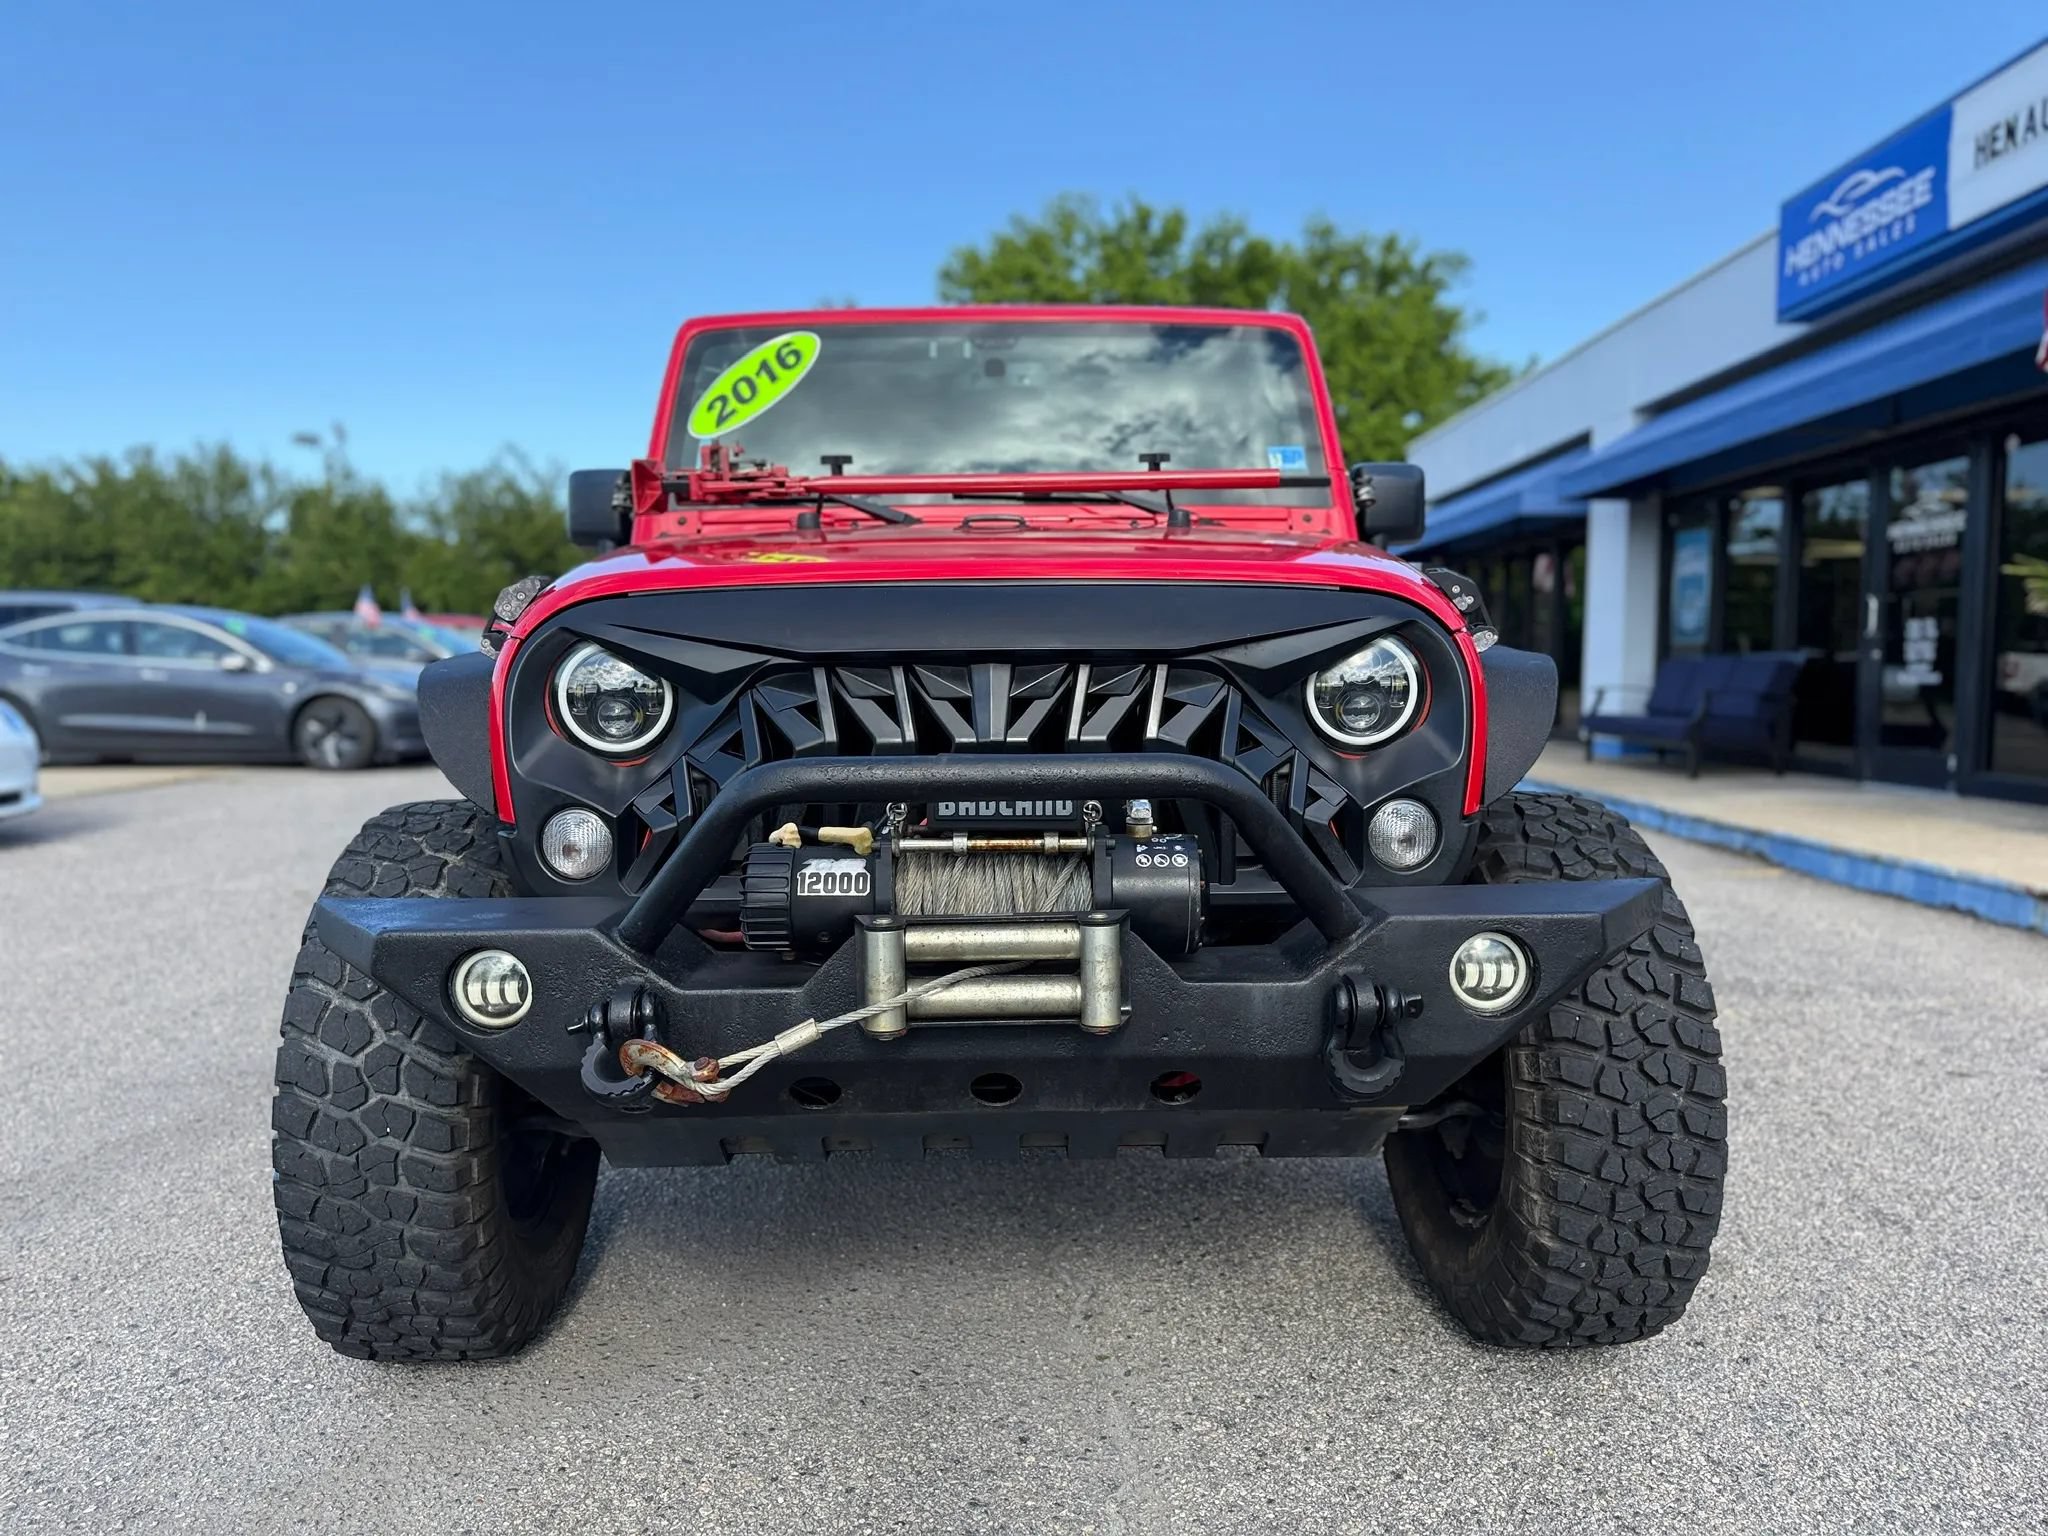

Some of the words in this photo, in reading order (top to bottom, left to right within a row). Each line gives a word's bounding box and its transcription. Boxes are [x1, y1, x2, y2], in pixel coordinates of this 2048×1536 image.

[1785, 165, 1936, 278] HENNESSEE
[706, 341, 803, 429] 2016
[798, 871, 869, 894] 12000
